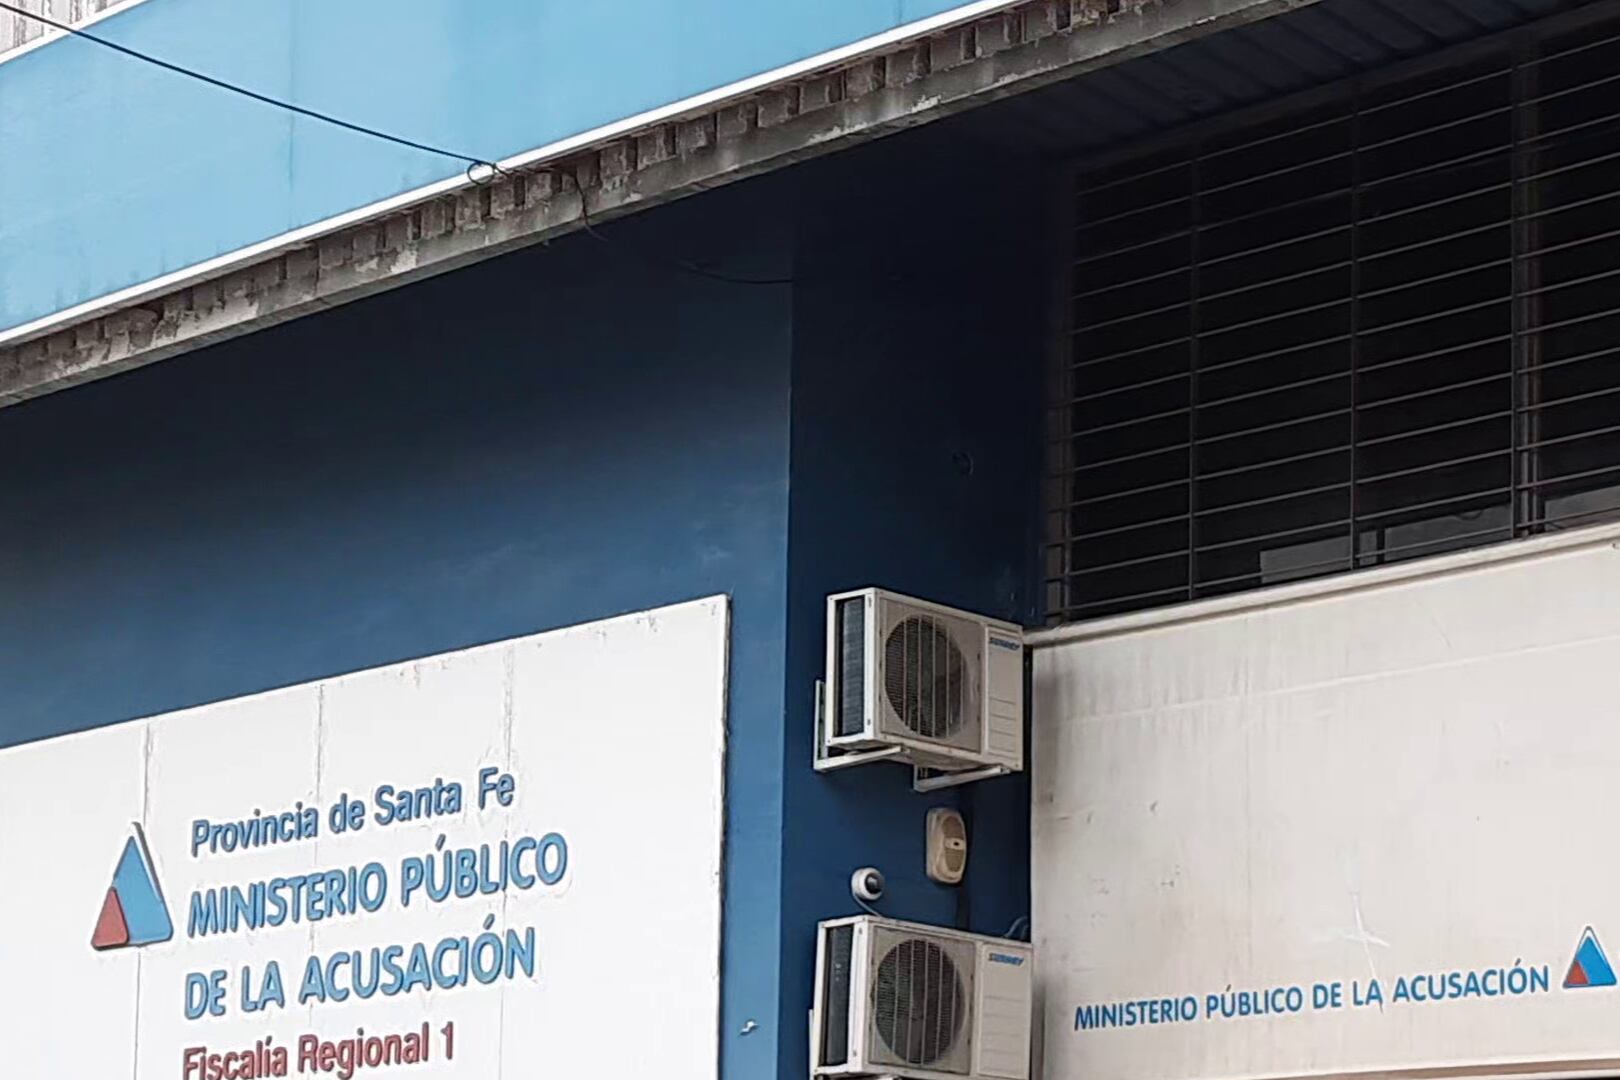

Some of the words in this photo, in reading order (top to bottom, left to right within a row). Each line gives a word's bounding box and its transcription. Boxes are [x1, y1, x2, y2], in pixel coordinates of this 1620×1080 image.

[191, 801, 319, 858] Provincia
[329, 793, 365, 834] de
[374, 778, 462, 826] Santa
[477, 766, 515, 810] Fe
[187, 862, 388, 938] MINISTERIO
[400, 833, 569, 907] PÚBLICO
[184, 969, 228, 1020] DE
[241, 960, 285, 1012] LA
[299, 913, 536, 1005] ACUSACIÓN
[1074, 996, 1198, 1031] MINISTERIO
[1206, 984, 1304, 1019] PÚBLICO
[1312, 983, 1342, 1010] DE
[1352, 978, 1384, 1007] LA
[1392, 958, 1549, 1003] ACUSACIÓN
[297, 1022, 430, 1080] Regional
[440, 1020, 454, 1061] 1
